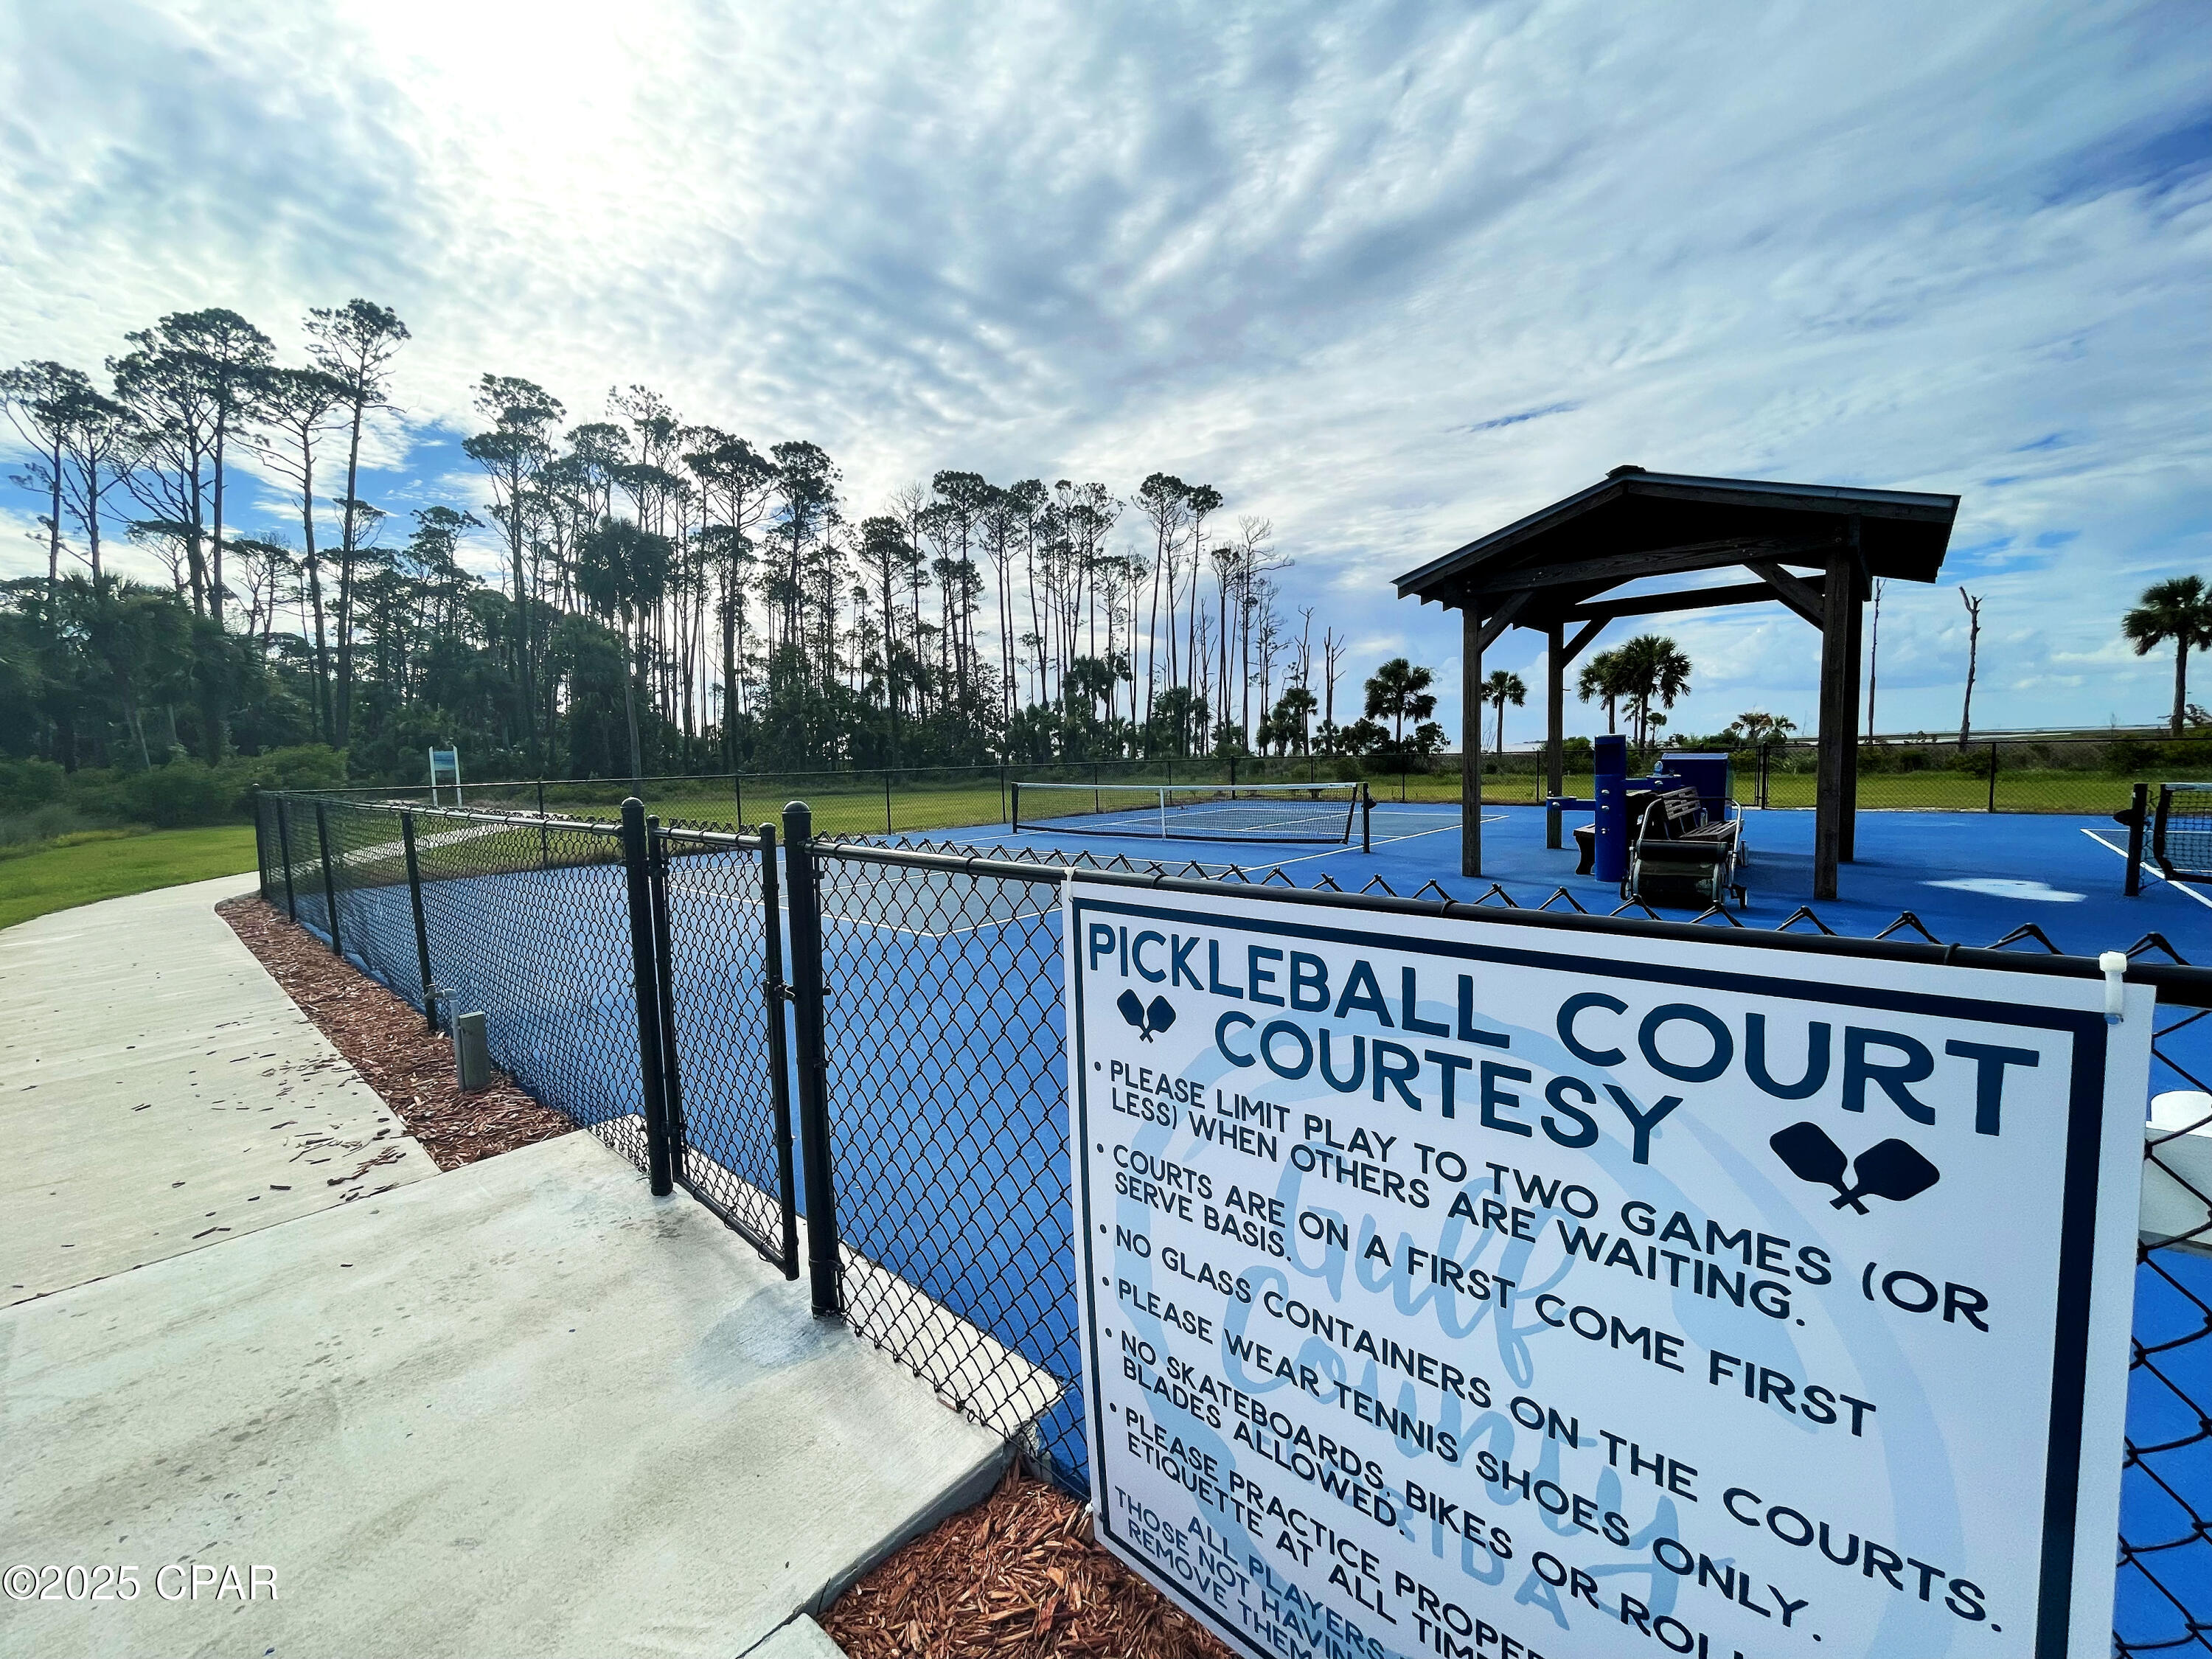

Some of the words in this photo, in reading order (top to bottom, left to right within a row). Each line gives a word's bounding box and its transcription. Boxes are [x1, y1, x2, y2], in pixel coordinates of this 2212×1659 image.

[1090, 923, 1510, 1048] PICKLEBALL
[1557, 992, 2039, 1136] COURT
[1215, 1011, 1683, 1165] COURTESY
[1111, 1060, 1205, 1109] PLEASE
[1217, 1089, 1290, 1133] LIMIT
[1305, 1114, 1397, 1162] PLAY
[1414, 1143, 1467, 1182] TO
[1486, 1162, 1598, 1219] TWO
[1621, 1201, 1832, 1284] GAMES
[1863, 1262, 1989, 1332] (OR
[1113, 1088, 1177, 1130] LESS)
[1189, 1111, 1276, 1162] WHEN
[1291, 1144, 1429, 1208] OTHERS
[1447, 1192, 1536, 1243] ARE
[1557, 1220, 1805, 1326] WAITING.
[1113, 1145, 1212, 1199] COURTS
[1225, 1186, 1285, 1228] ARE
[1299, 1212, 1348, 1251] ON
[1364, 1235, 1391, 1267] A
[1408, 1246, 1515, 1309] FIRST
[1535, 1294, 1684, 1373] COME
[1710, 1350, 1876, 1437] FIRST
[1116, 1172, 1193, 1222] SERVE
[1204, 1205, 1291, 1262] BASIS.
[1275, 1141, 1580, 1388] Gulf
[1115, 1486, 1189, 1556] THOSE
[1199, 1545, 1250, 1598] NOT
[1116, 1225, 1151, 1258] NO
[1162, 1248, 1251, 1303] GLASS
[1264, 1291, 1491, 1408] CONTAINERS
[1510, 1397, 1578, 1449] ON
[1600, 1430, 1697, 1502] THE
[1723, 1488, 2001, 1632] COURTS.
[1119, 1279, 1213, 1344] PLEASE
[1224, 1328, 1319, 1397] WEAR
[1333, 1380, 1458, 1462] TENNIS
[1476, 1451, 1630, 1546] SHOES
[1653, 1537, 1820, 1641] ONLY.
[1122, 1330, 1156, 1365] NO
[1406, 1480, 1512, 1559] BIKES
[1532, 1551, 1600, 1610] OR
[1124, 1356, 1220, 1428] BLADES
[1234, 1421, 1408, 1537] ALLOWED.
[1127, 1407, 1219, 1483] PLEASE
[1230, 1470, 1380, 1584] PRACTICE
[1396, 1571, 1545, 1659] PROPE
[1128, 1432, 1263, 1538] ETIQUETTE
[1276, 1531, 1313, 1568] AT
[1328, 1564, 1397, 1625] ALL
[1412, 1610, 1488, 1659] TIM
[1188, 1517, 1238, 1565] ALL
[1222, 1265, 1735, 1627] County
[1128, 1518, 1227, 1610] REMOVE
